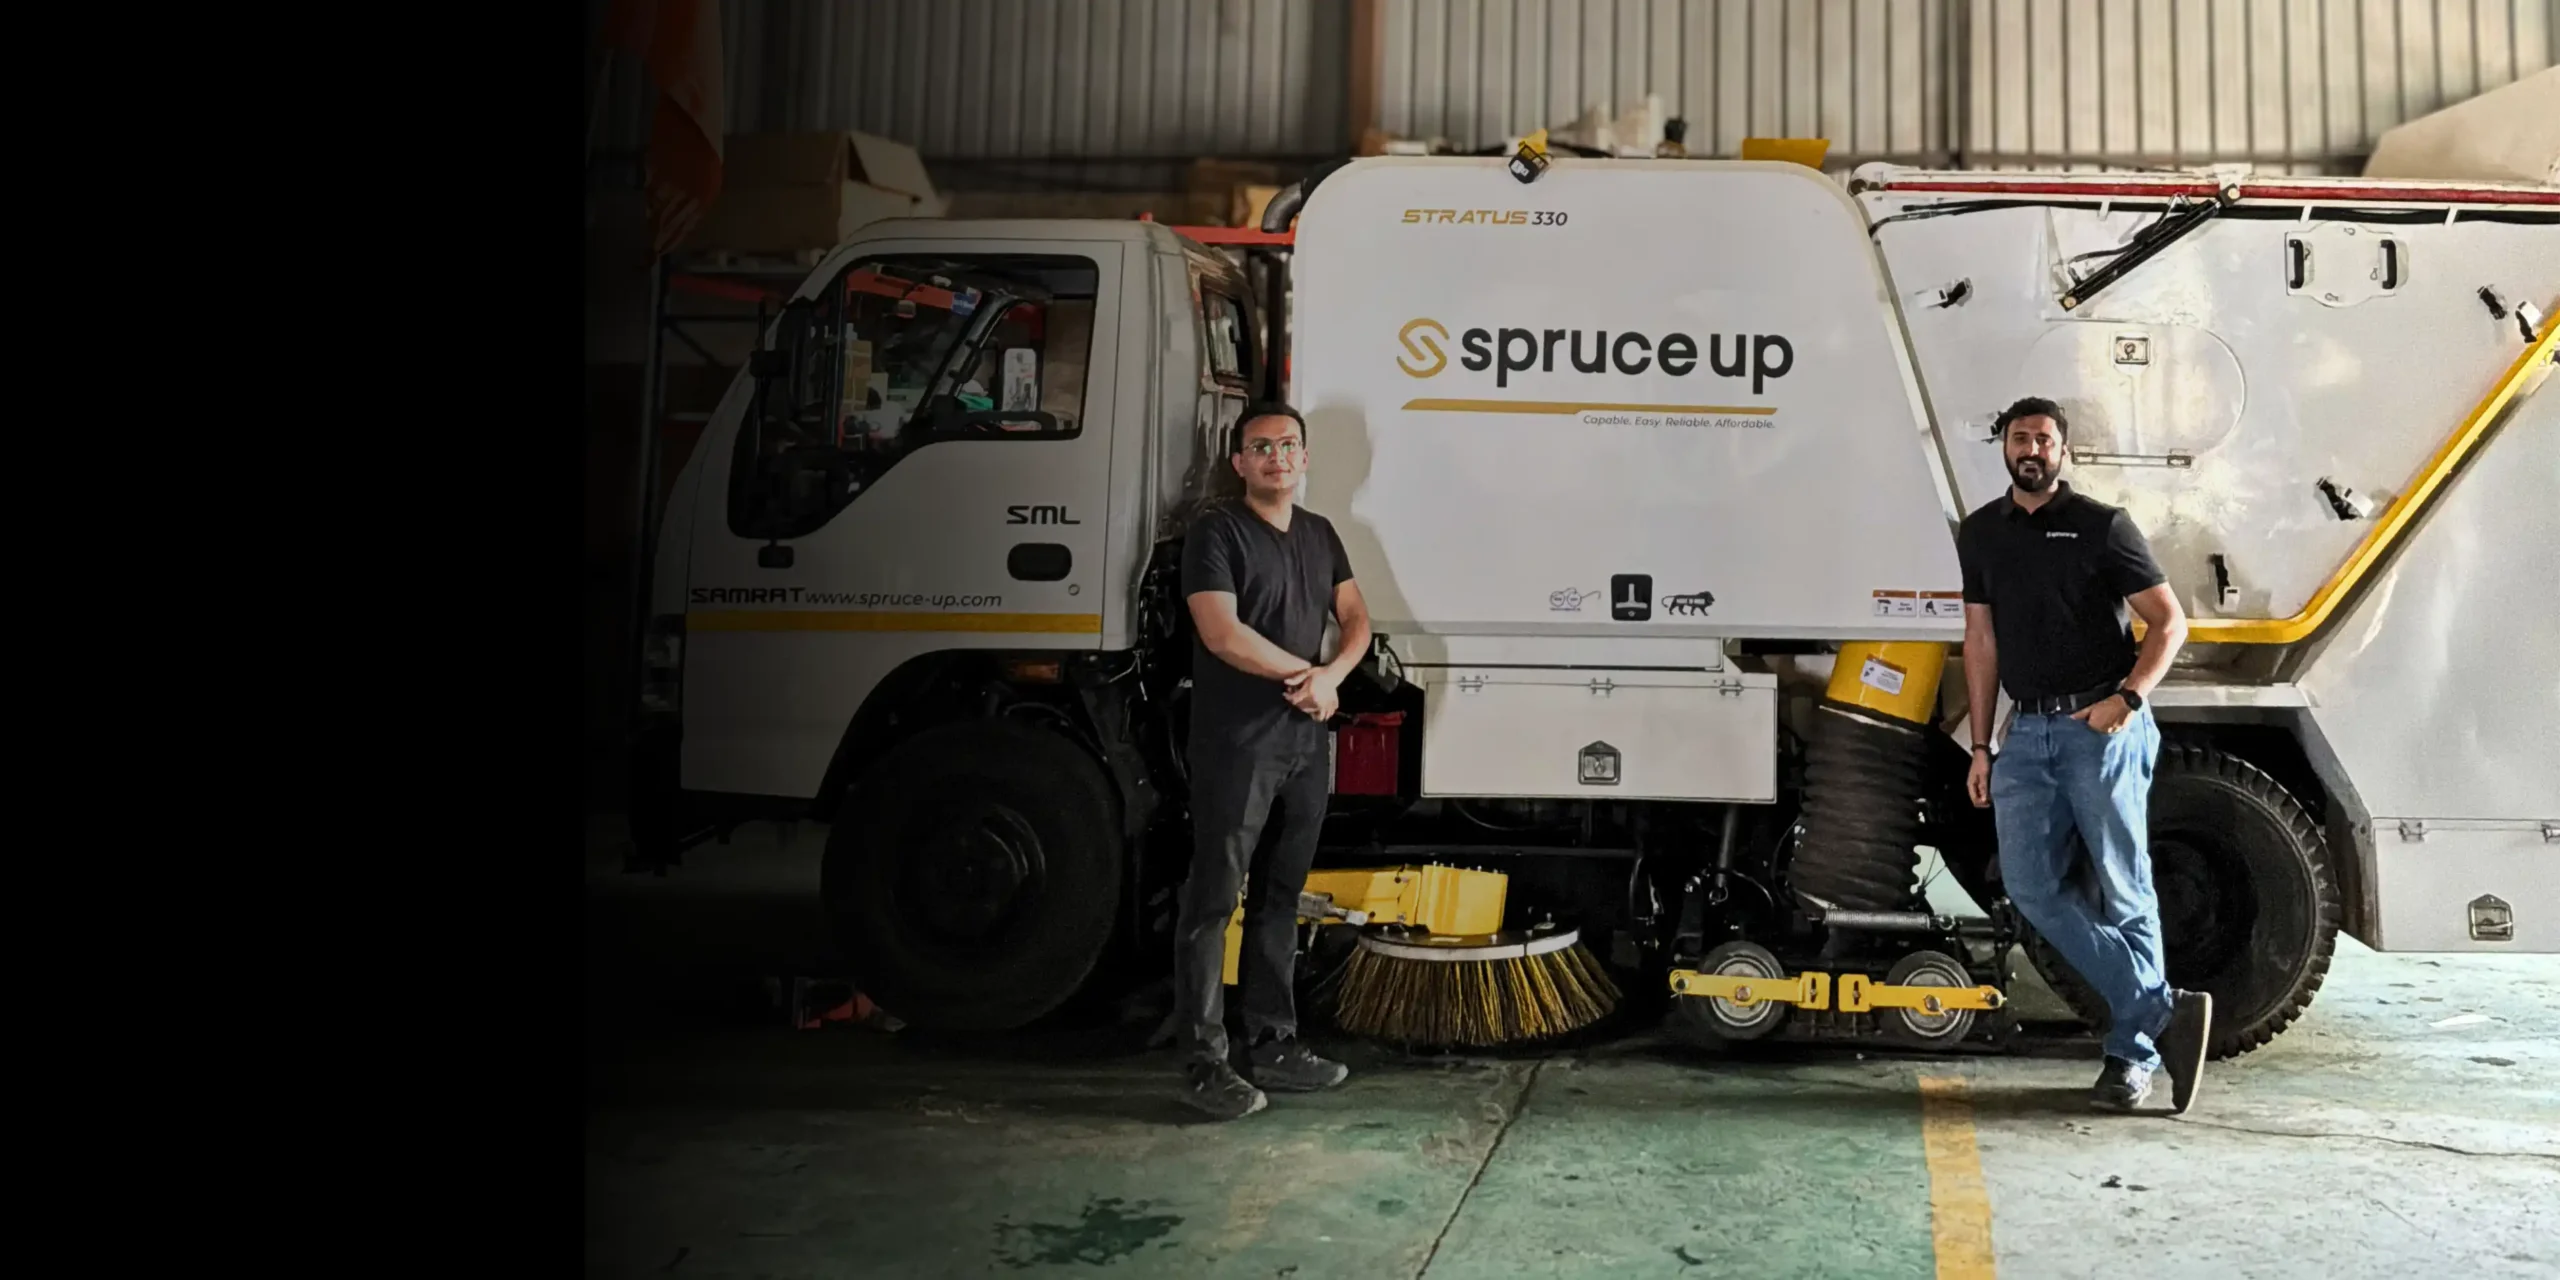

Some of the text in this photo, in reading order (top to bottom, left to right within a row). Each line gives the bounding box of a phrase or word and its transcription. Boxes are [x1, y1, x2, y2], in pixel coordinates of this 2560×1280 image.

[1401, 209, 1568, 227] STRATUS 330
[1461, 327, 1698, 388] spruce
[1710, 333, 1793, 395] up
[1583, 414, 1632, 427] Capable.
[1665, 416, 1712, 428] Reliable.
[1714, 417, 1776, 430] Affordable.
[1006, 505, 1081, 526] SML
[691, 587, 1003, 610] SAMRAT www.spruce-up.com
